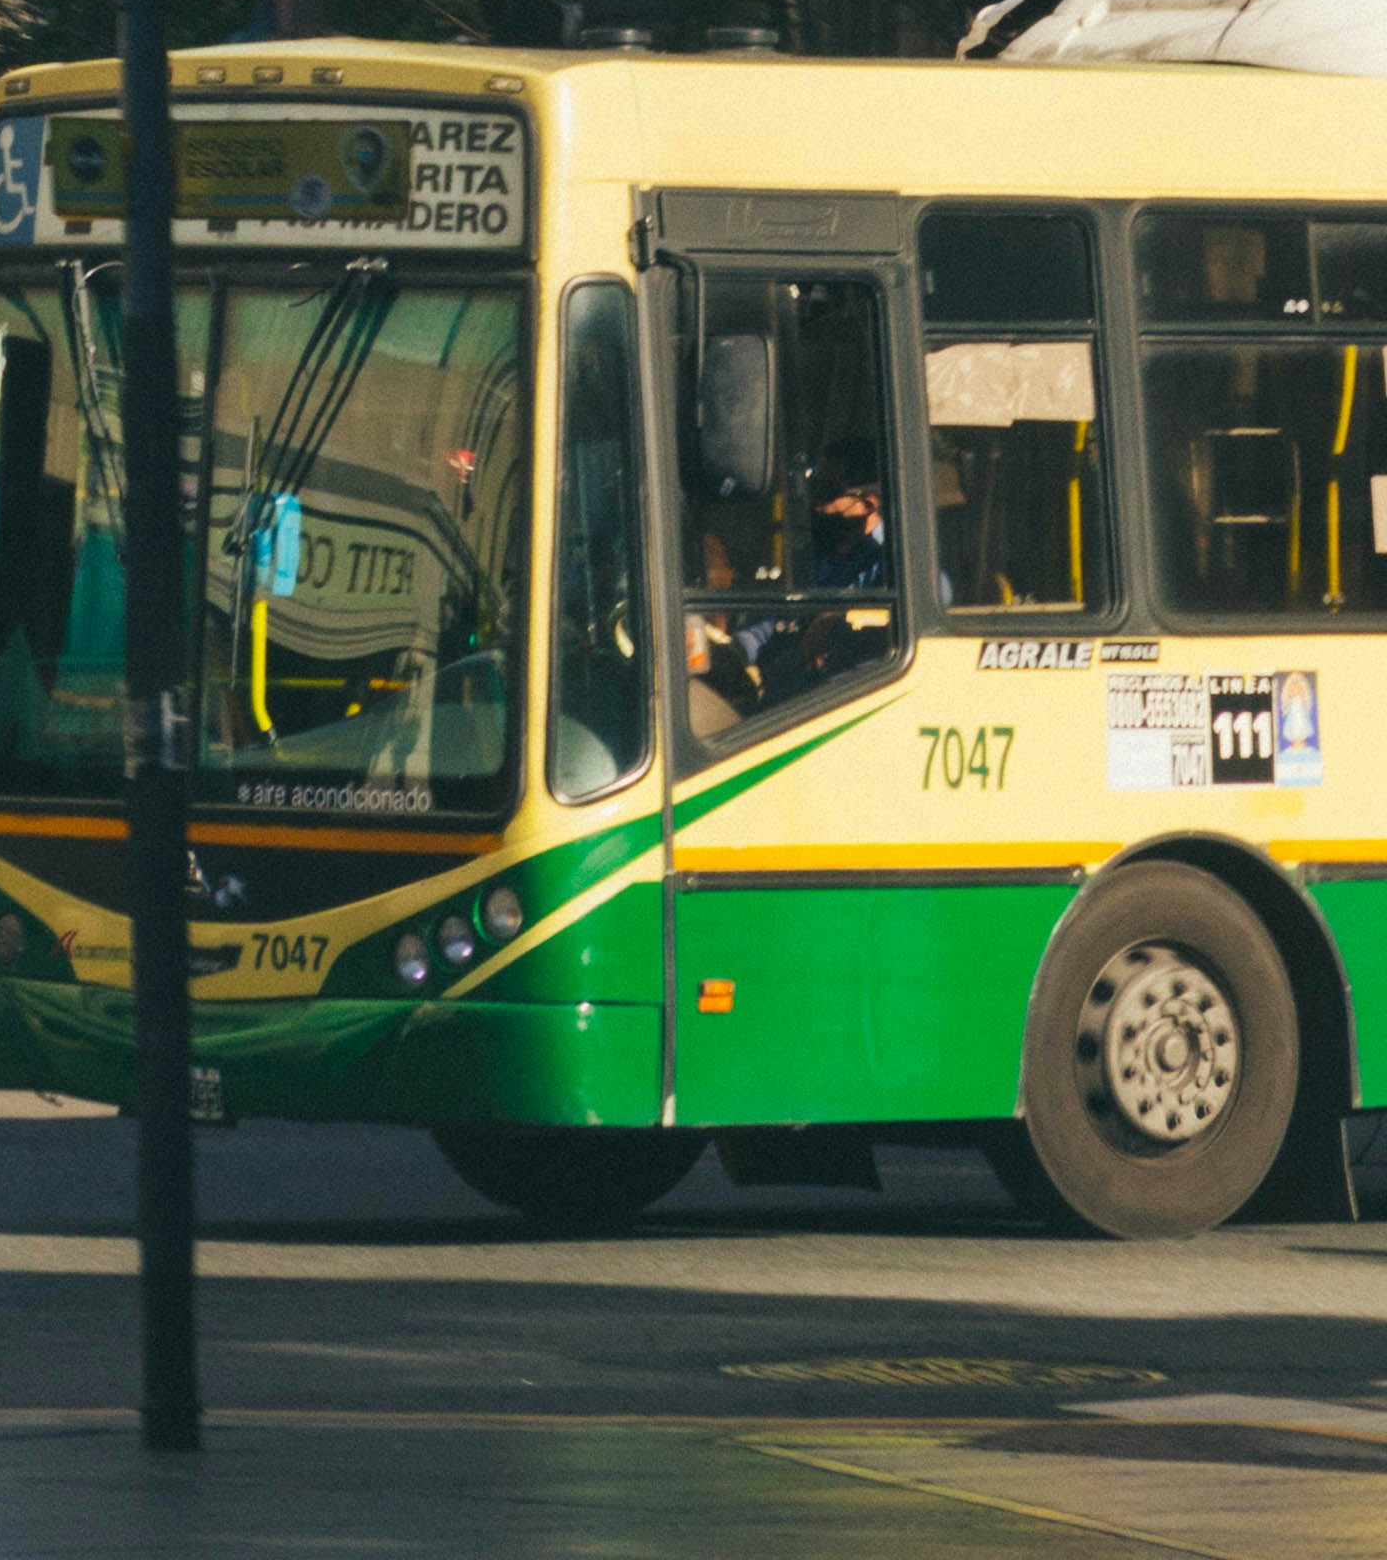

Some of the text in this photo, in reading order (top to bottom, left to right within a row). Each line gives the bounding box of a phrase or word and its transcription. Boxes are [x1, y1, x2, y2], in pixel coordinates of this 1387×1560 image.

[411, 122, 515, 153] AREZ
[410, 165, 510, 195] RITA
[979, 640, 1093, 670] AGRALE
[1210, 677, 1273, 695] LINEA
[1214, 710, 1274, 761] 111
[919, 726, 1014, 791] 7047
[291, 781, 433, 813] acondicionado
[251, 933, 329, 971] 7047
